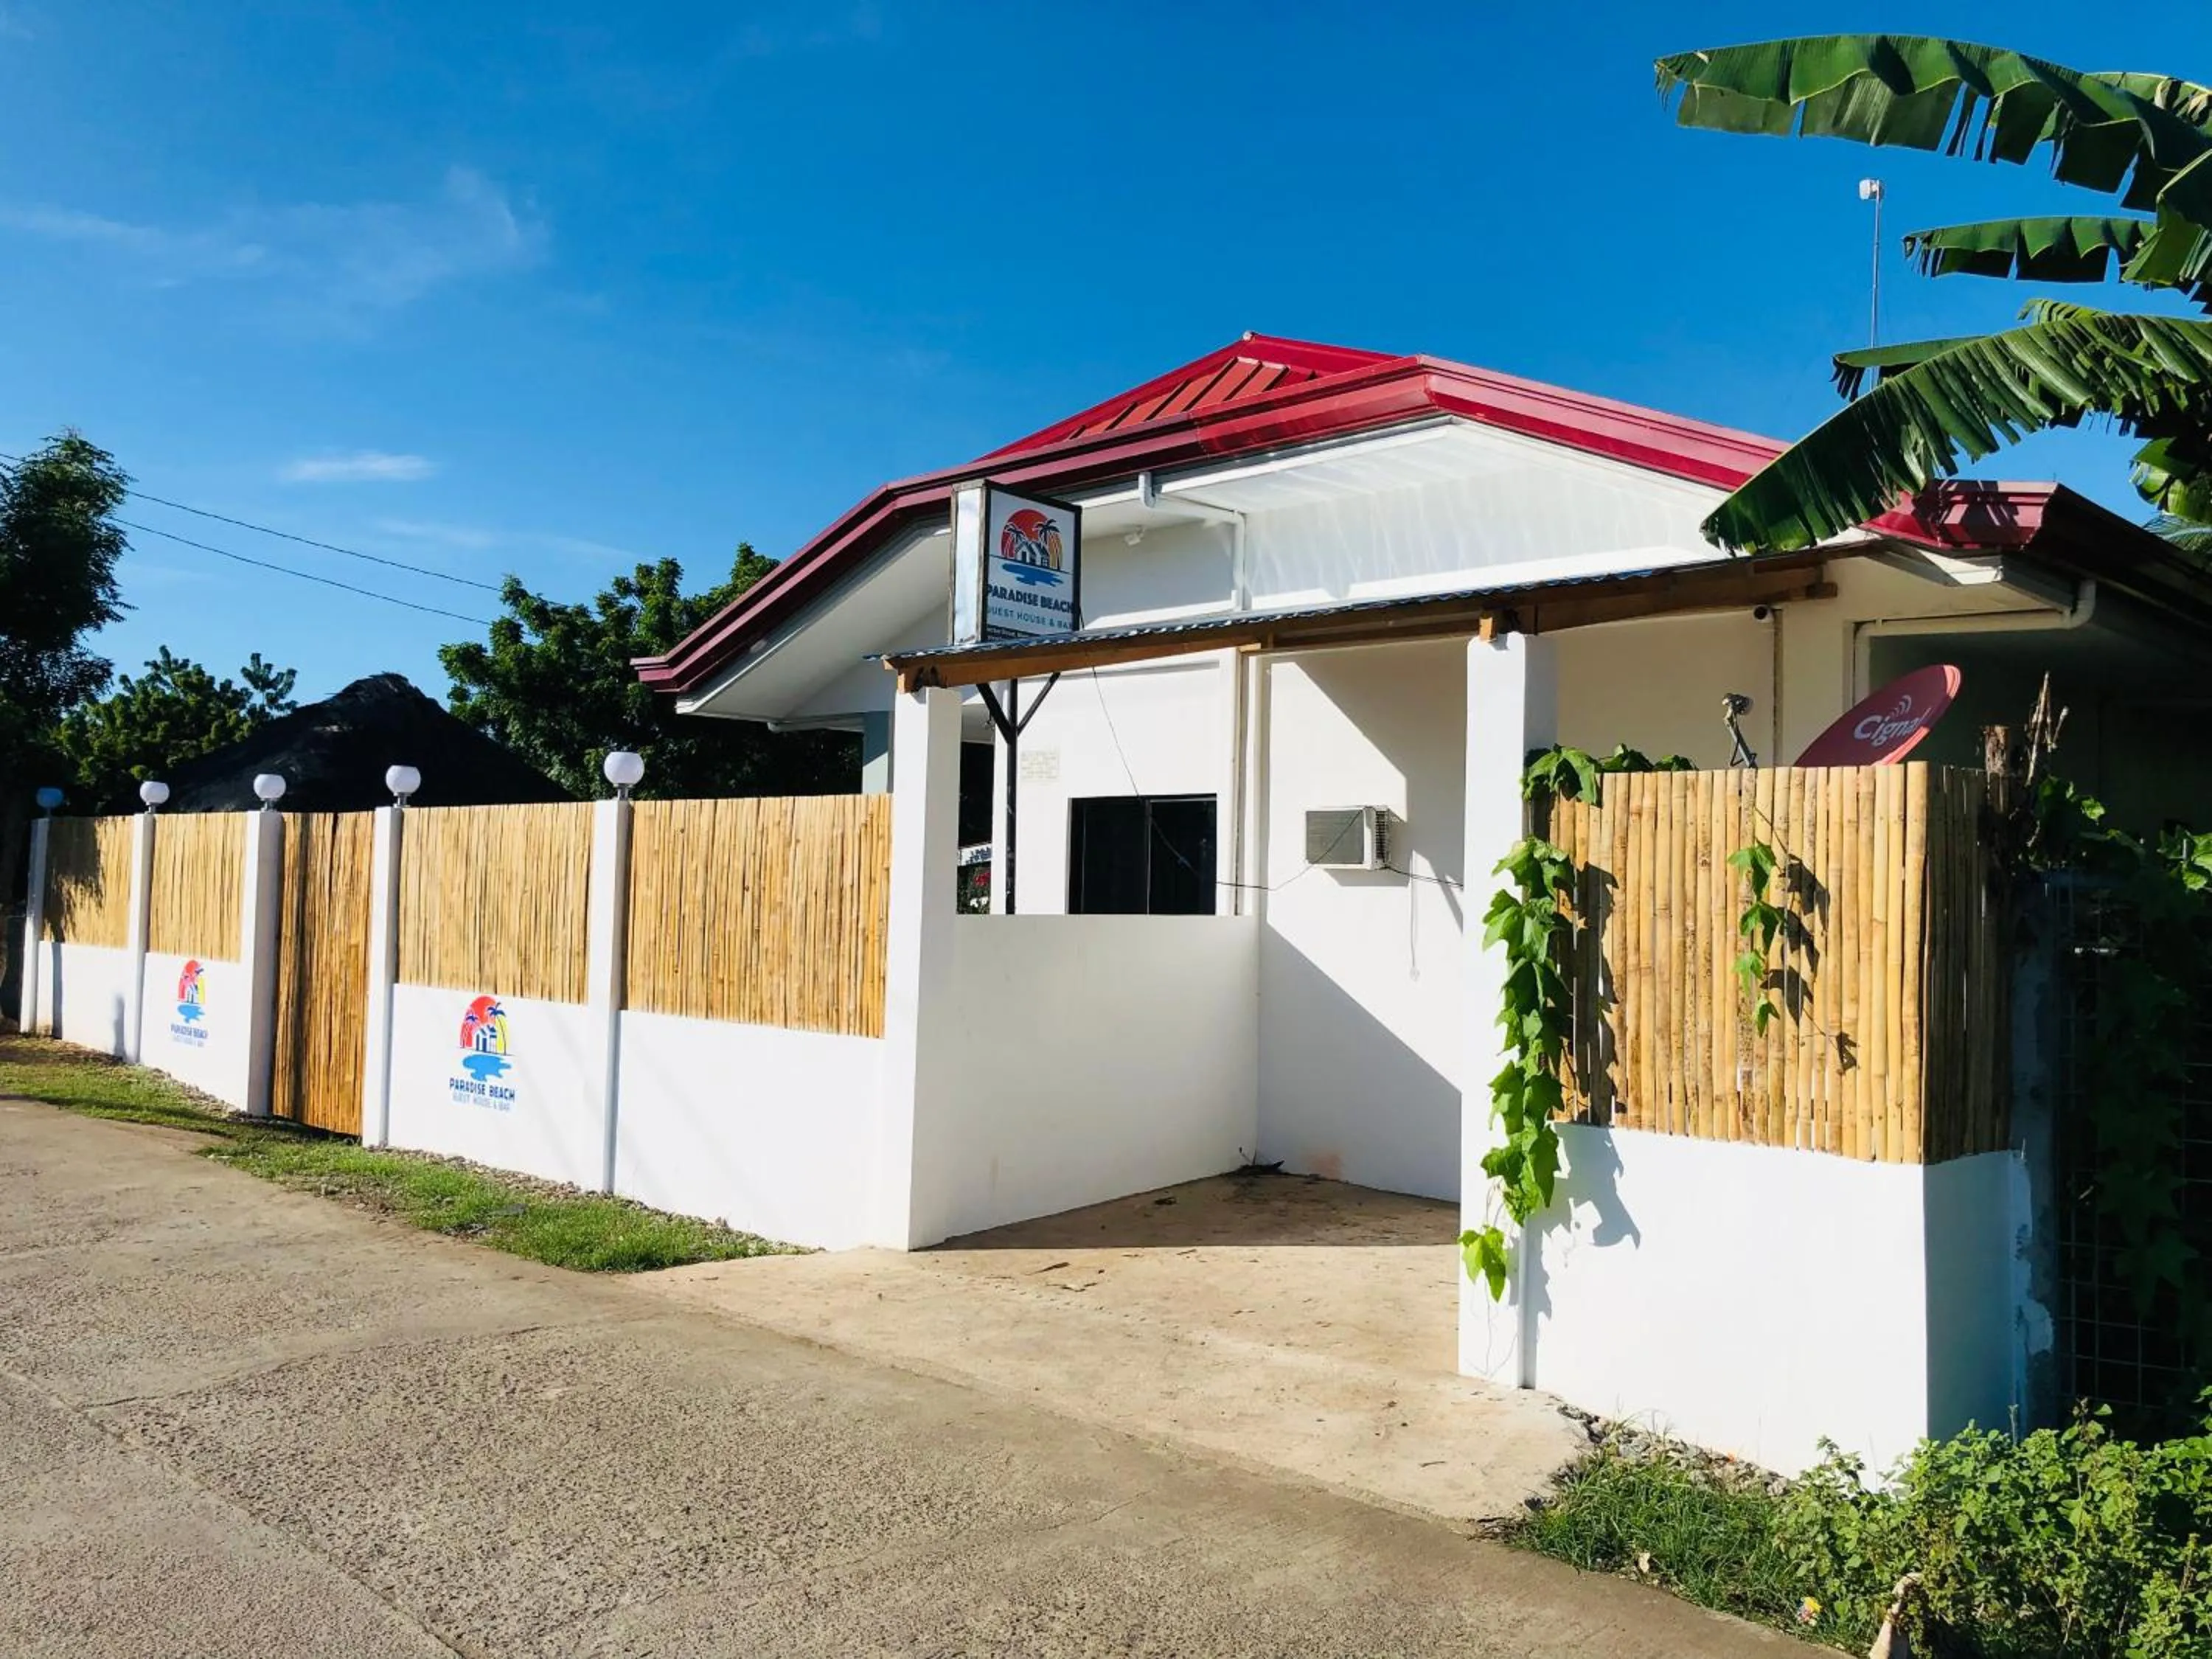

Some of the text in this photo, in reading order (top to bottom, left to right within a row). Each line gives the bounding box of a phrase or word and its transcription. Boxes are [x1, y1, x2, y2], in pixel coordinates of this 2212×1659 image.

[987, 583, 1074, 613] PARADISE BEACH
[1017, 611, 1046, 625] HOUSE
[1049, 619, 1055, 627] &
[449, 1077, 515, 1102] PARADISE BEACH
